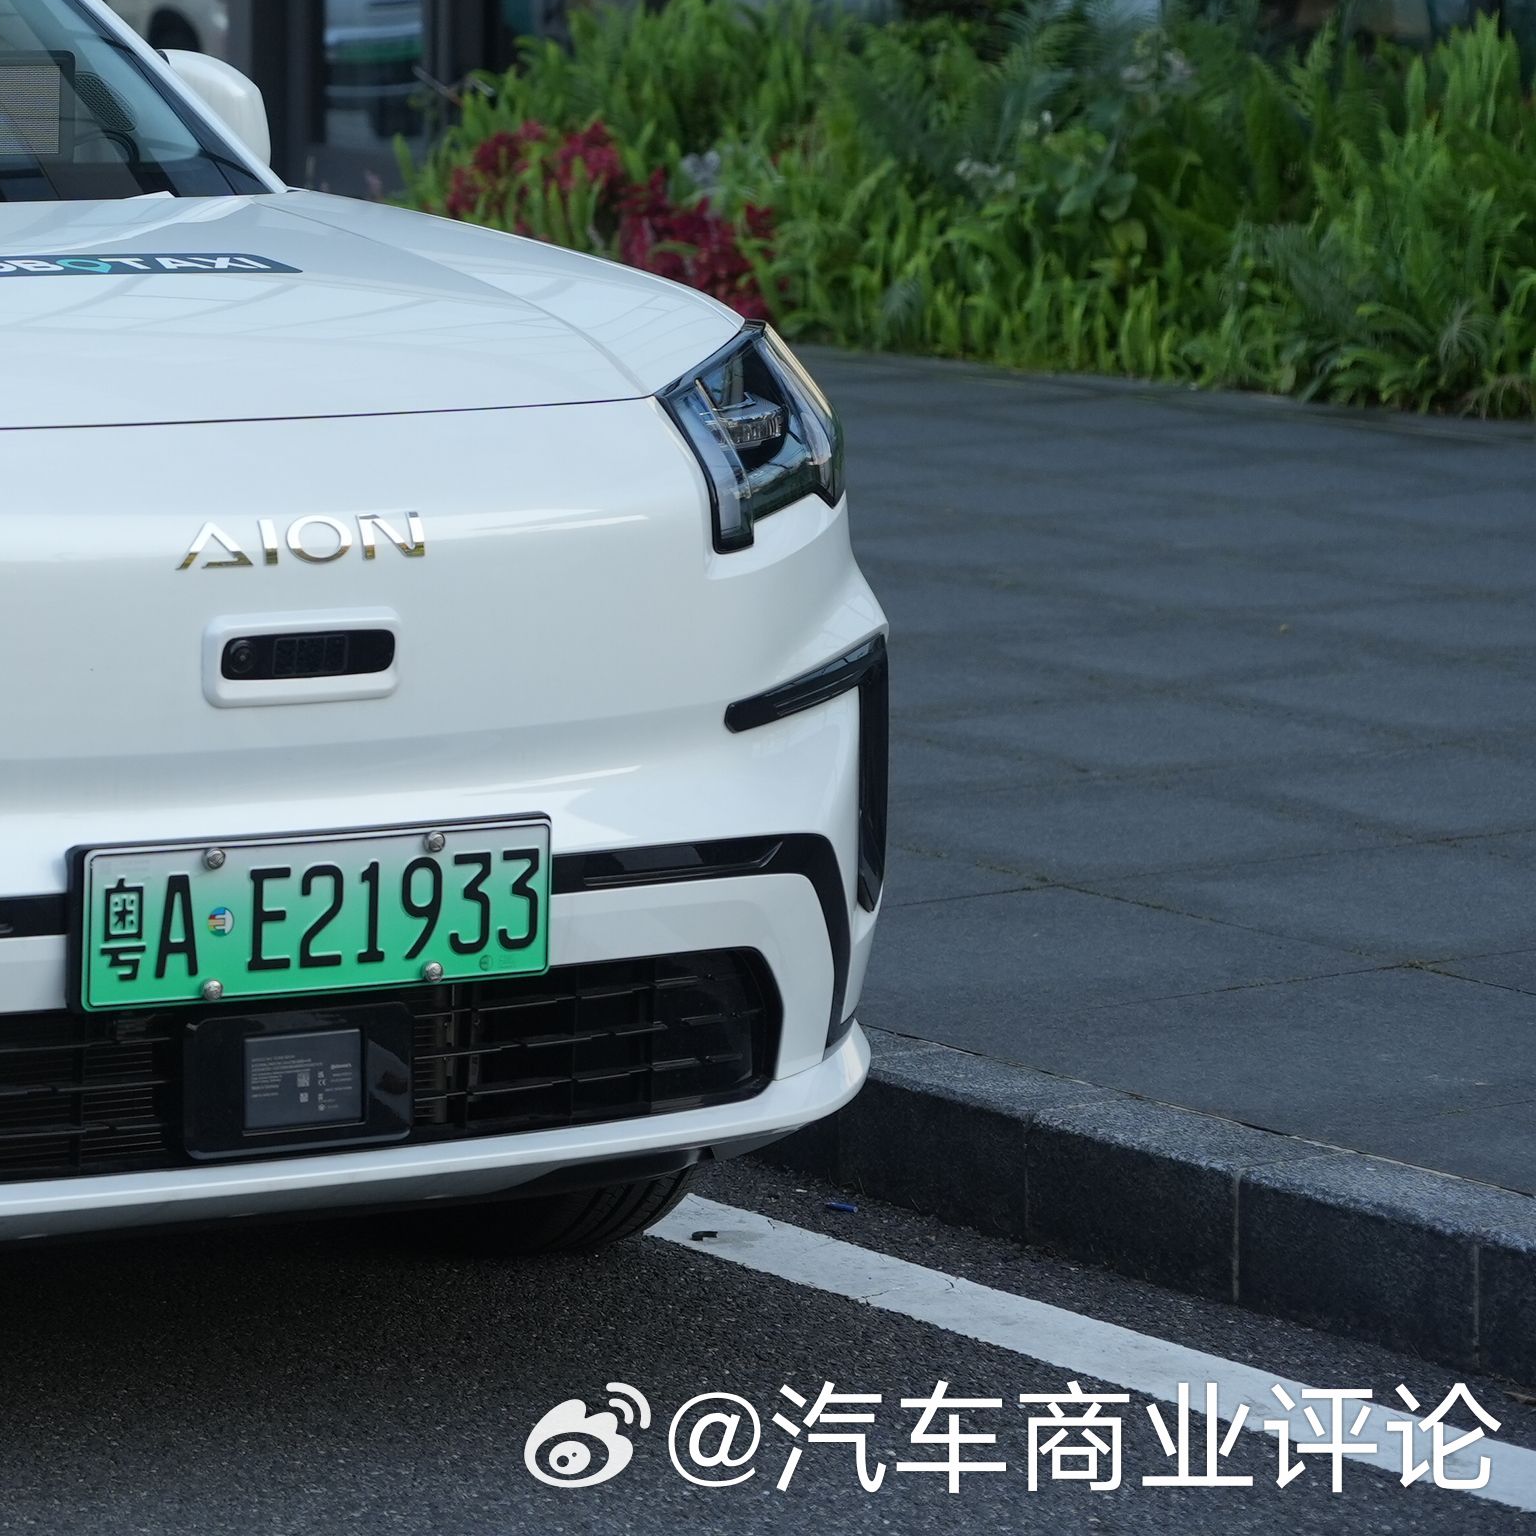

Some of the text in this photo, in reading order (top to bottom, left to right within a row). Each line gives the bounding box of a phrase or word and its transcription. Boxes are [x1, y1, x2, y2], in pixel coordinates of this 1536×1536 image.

[175, 510, 426, 570] AION
[100, 848, 541, 982] 粤A E21933
